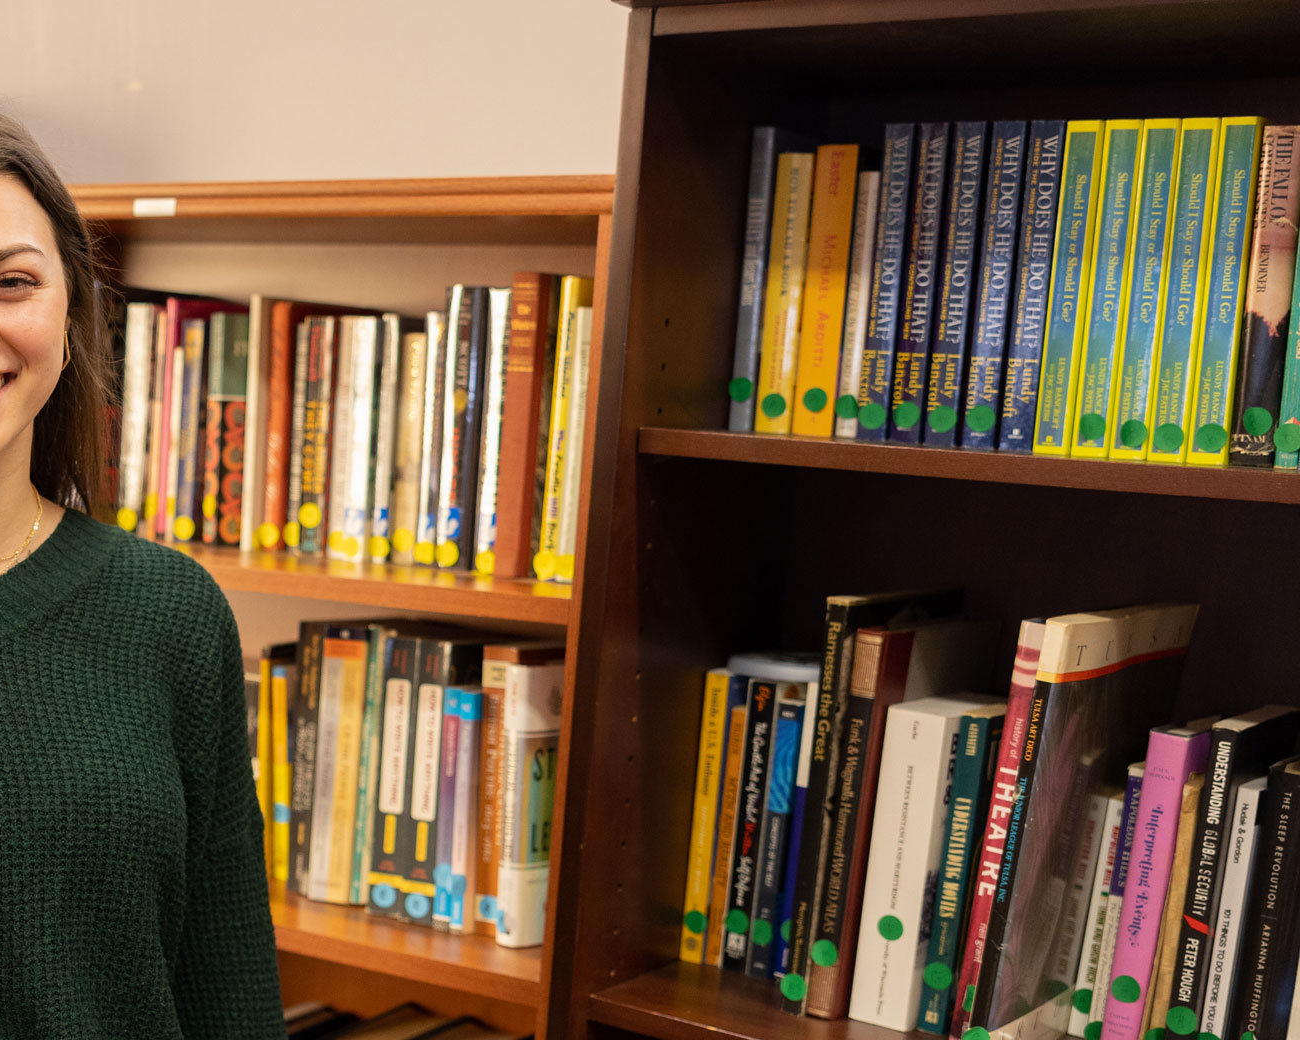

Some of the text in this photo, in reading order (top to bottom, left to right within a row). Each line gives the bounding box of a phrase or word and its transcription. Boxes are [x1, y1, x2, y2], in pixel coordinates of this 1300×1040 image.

[1032, 138, 1040, 166] INSIDE
[1275, 132, 1294, 165] THE
[828, 150, 845, 195] Easter
[1151, 172, 1165, 208] Should
[1230, 169, 1246, 206] Should
[1271, 168, 1291, 205] FALL
[1028, 190, 1036, 214] MINDS
[1073, 175, 1087, 209] Should
[1114, 173, 1129, 209] Should
[1188, 173, 1202, 209] Should
[875, 136, 909, 341] WHY DOES HE DO THAT?
[910, 136, 944, 343] WHY DOES HE DO THAT?
[946, 134, 982, 344] WHY DOES HE DO THAT?
[984, 136, 1021, 347] WHY DOES HE DO THAT?
[1022, 135, 1059, 348] WHY DOES HE DO THAT?
[1024, 225, 1032, 252] ANGRY
[1067, 221, 1081, 241] Stay
[1109, 218, 1123, 241] Stay
[1147, 219, 1159, 241] Stay
[1183, 220, 1196, 243] Stay
[1226, 216, 1240, 239] Stay
[1070, 244, 1077, 253] or
[1111, 243, 1118, 253] or
[1148, 244, 1155, 254] or
[1184, 245, 1191, 255] or
[1227, 242, 1235, 252] or
[1064, 257, 1081, 291] Should
[1104, 256, 1118, 290] Should
[1141, 256, 1155, 292] Should
[1178, 258, 1192, 294] Should
[1221, 255, 1236, 291] Should
[1256, 245, 1270, 294] BENDINER
[812, 234, 837, 368] MICHAEL ARDITTI
[1017, 267, 1028, 324] CONTROLLING
[1060, 302, 1072, 323] Go?
[1101, 302, 1113, 323] Go?
[1139, 302, 1150, 323] Go?
[1218, 301, 1230, 323] Go?
[1176, 304, 1186, 326] Go?
[873, 350, 892, 394] Lundy
[906, 352, 924, 397] Lundy
[942, 354, 960, 398] Lundy
[981, 357, 1000, 401] Lundy
[1003, 358, 1023, 417] Bancroft
[1019, 358, 1037, 404] Lundy
[1213, 360, 1224, 390] LUNDY
[1052, 358, 1066, 428] LUNDY BANCROFT
[814, 621, 841, 761] Ramesses the Great
[1010, 718, 1024, 758] history of
[1025, 699, 1043, 761] TULSA ART DECO
[823, 719, 863, 934] Funk & Wagnalls Hammond WORLD ATLAS
[1122, 788, 1140, 847] NAPOLEON
[1239, 803, 1250, 825] Hudak
[945, 797, 971, 879] UNDERSTANDING
[1007, 820, 1020, 848] LEAGUE
[1233, 836, 1245, 863] Gordon
[1266, 792, 1292, 908] THE SLEEP REVOLUTION
[1006, 851, 1015, 861] OF
[1128, 804, 1164, 935] Interpreting Events
[1178, 741, 1231, 1001] UNDERSTANDING GLOBAL SECURITY PETER HOUGH
[940, 881, 960, 918] MOVIES
[973, 922, 987, 962] neil grant
[1208, 908, 1232, 1019] 101 THINGS TO DO BEFORE YOU
[1248, 924, 1271, 1030] ARIANNA HUFFINGTO
